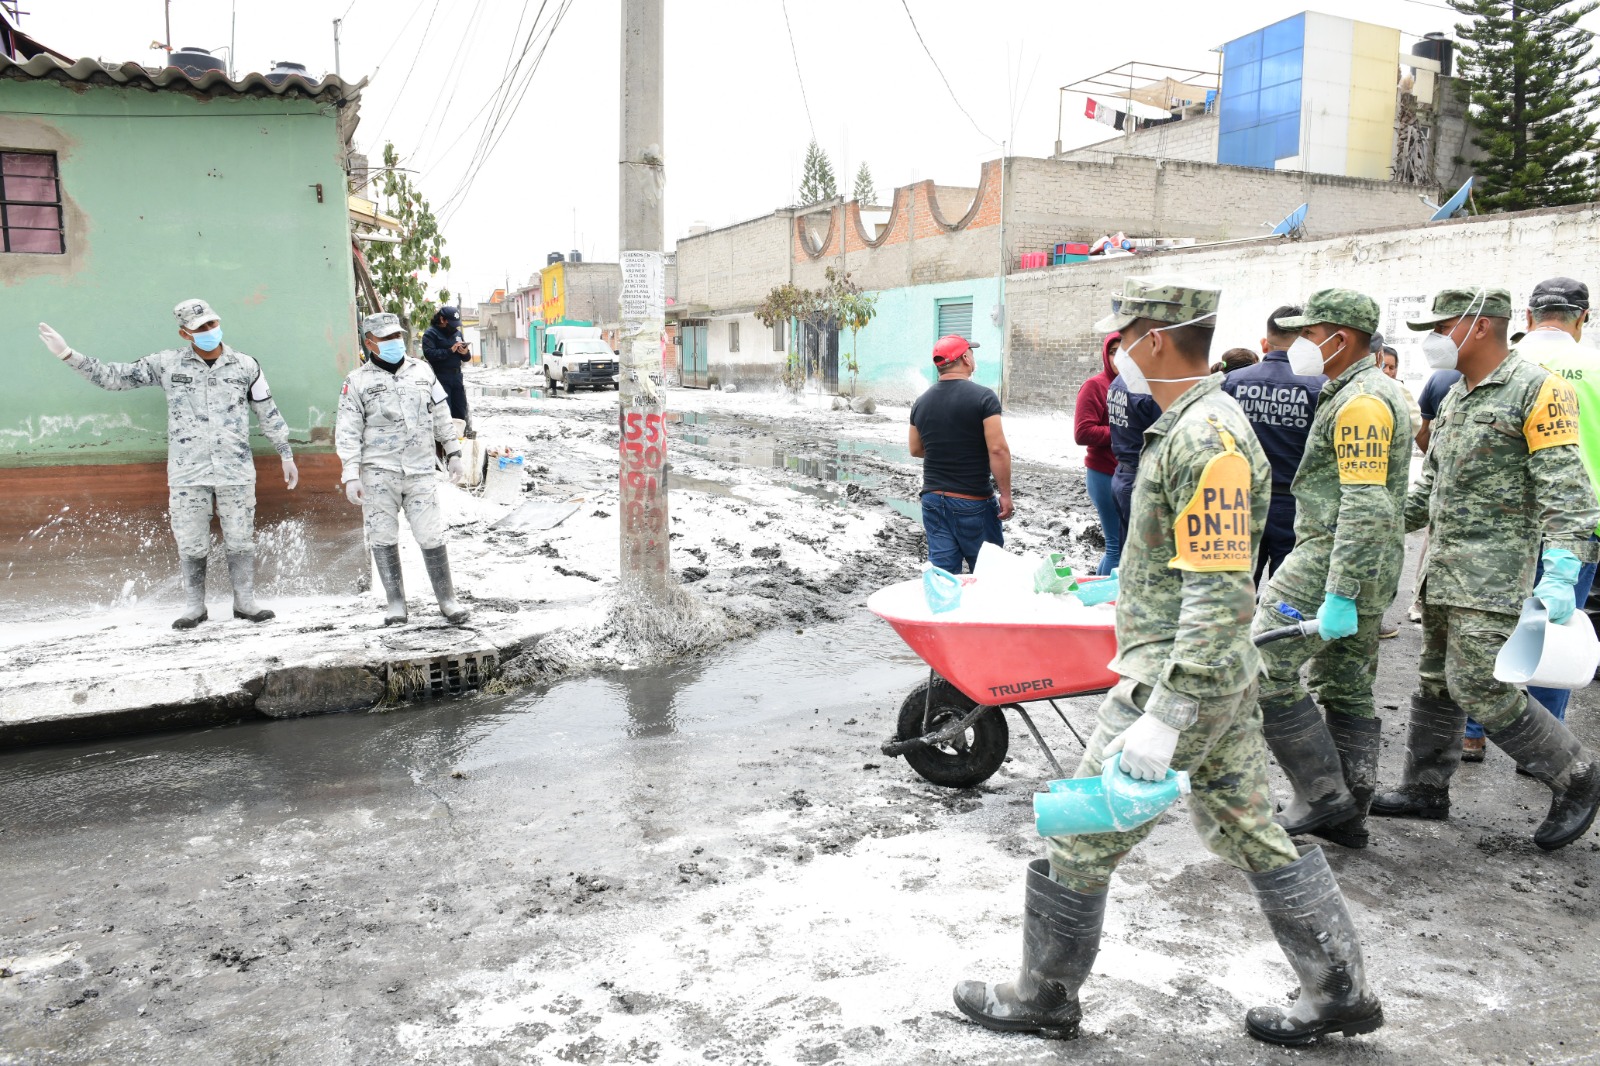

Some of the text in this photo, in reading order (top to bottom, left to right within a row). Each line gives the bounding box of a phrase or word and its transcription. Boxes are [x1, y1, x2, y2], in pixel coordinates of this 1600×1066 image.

[1555, 369, 1582, 380] IAS
[1236, 385, 1308, 404] POLICÍA
[1552, 388, 1576, 404] PLAN
[625, 413, 660, 442] 55
[1341, 425, 1390, 441] PLAN
[626, 442, 662, 470] 30
[988, 678, 1054, 697] TRUPER
